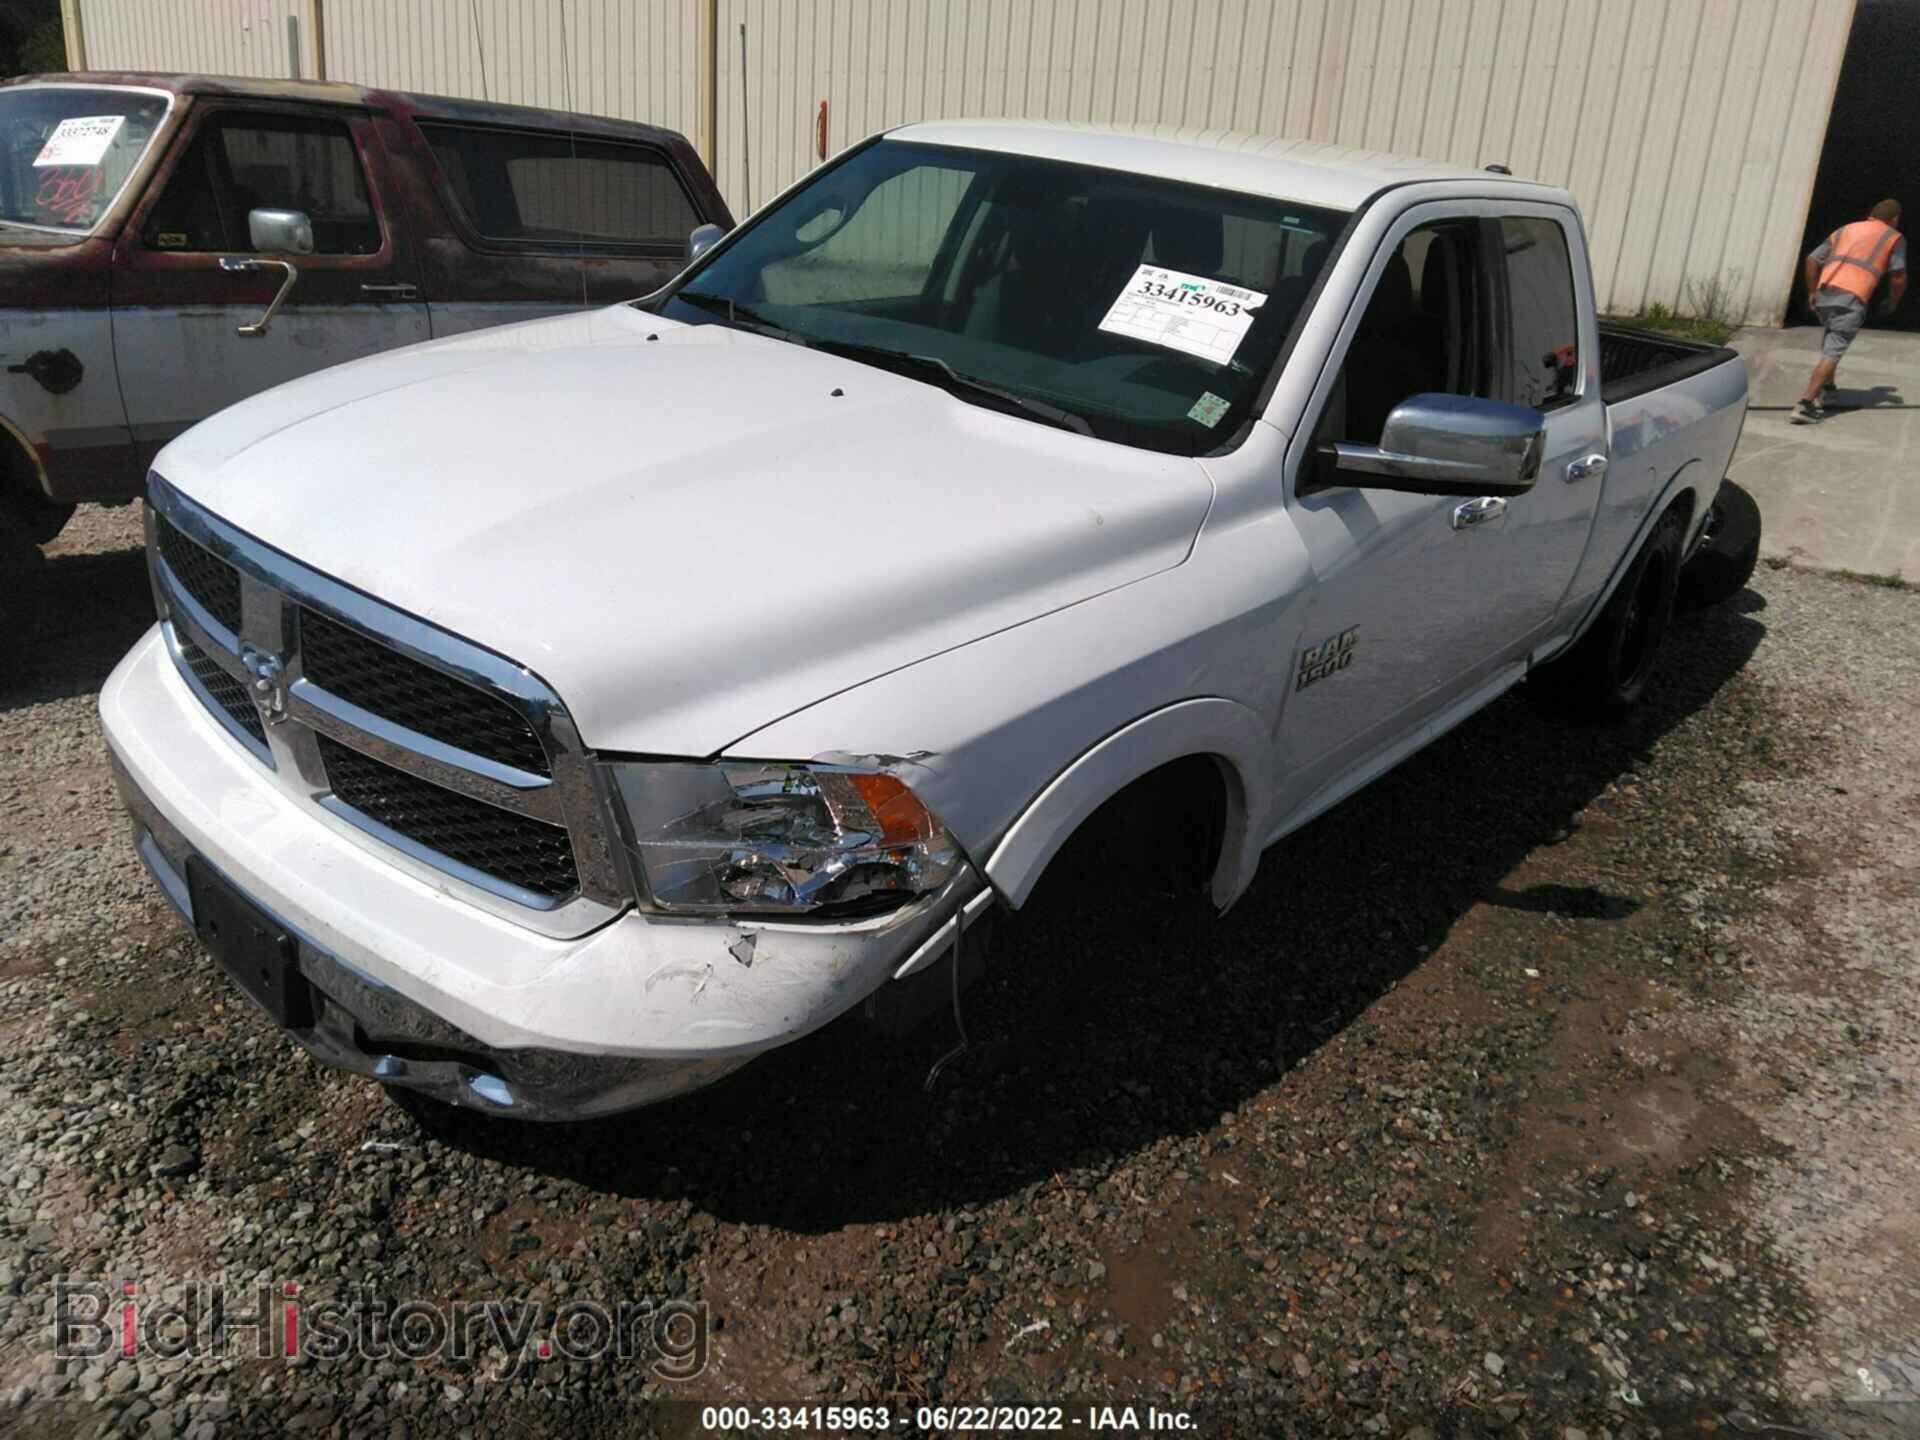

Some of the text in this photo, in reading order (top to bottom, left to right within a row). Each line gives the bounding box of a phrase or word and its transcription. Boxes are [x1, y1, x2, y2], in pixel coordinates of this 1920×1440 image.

[1137, 281, 1241, 317] 33415963
[1301, 624, 1360, 670] RAM
[1296, 648, 1352, 692] 1500
